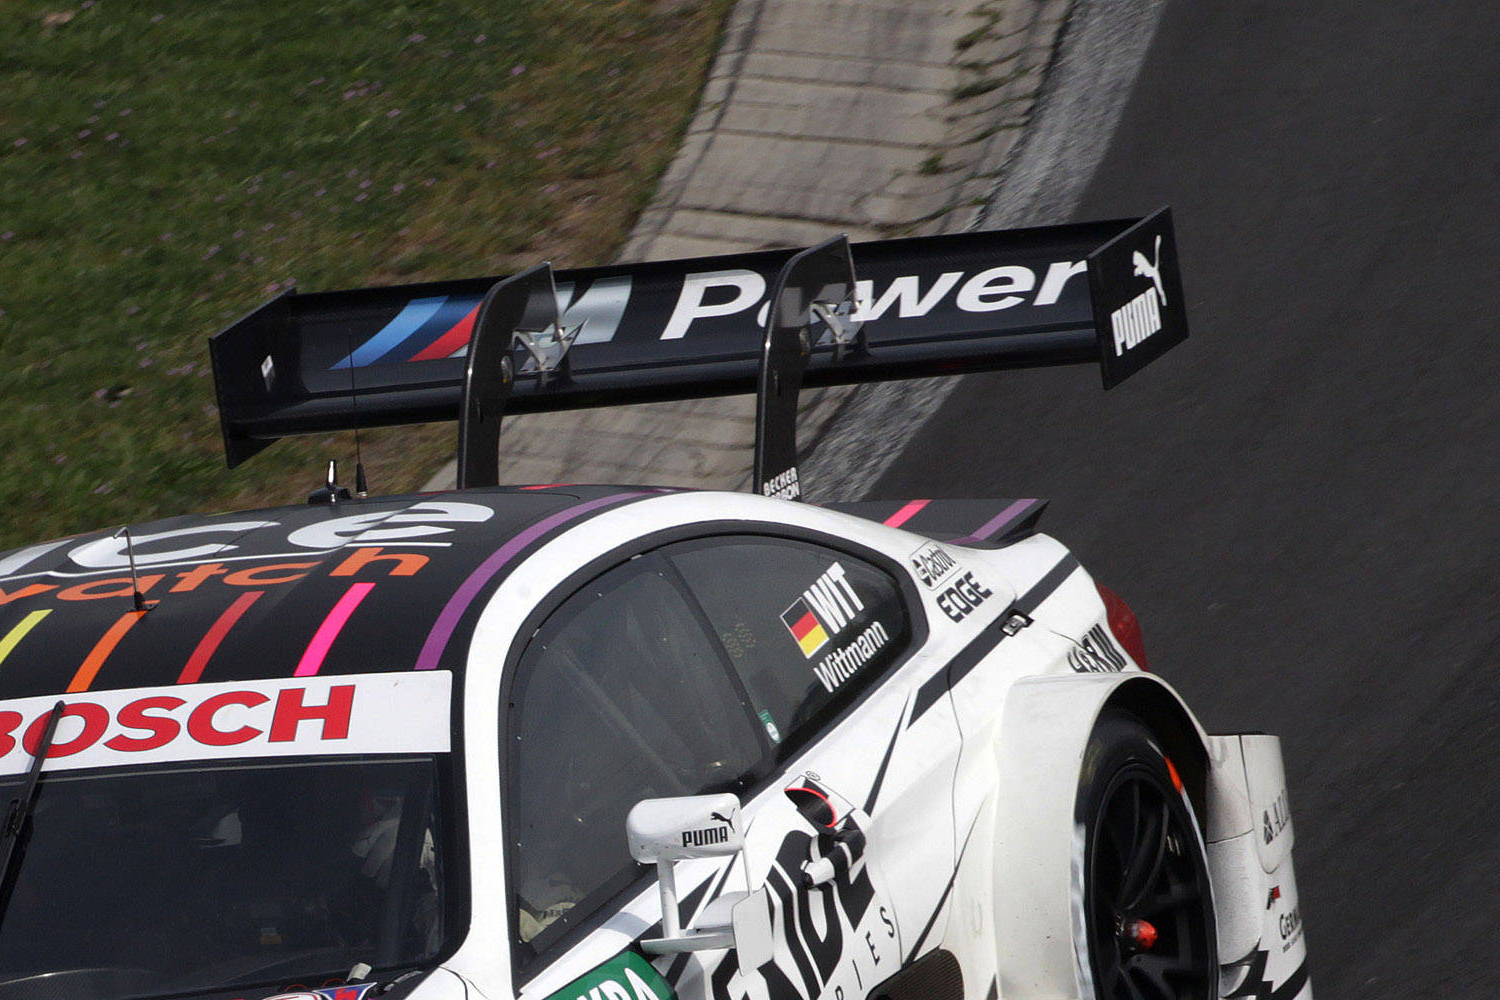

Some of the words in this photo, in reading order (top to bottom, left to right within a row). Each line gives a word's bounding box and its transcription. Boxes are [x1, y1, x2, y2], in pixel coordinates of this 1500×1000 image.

[1111, 286, 1162, 357] PUMA
[803, 561, 865, 635] WIT
[936, 571, 993, 623] EDGE
[813, 620, 889, 693] Wittmann
[682, 826, 729, 848] PUMA
